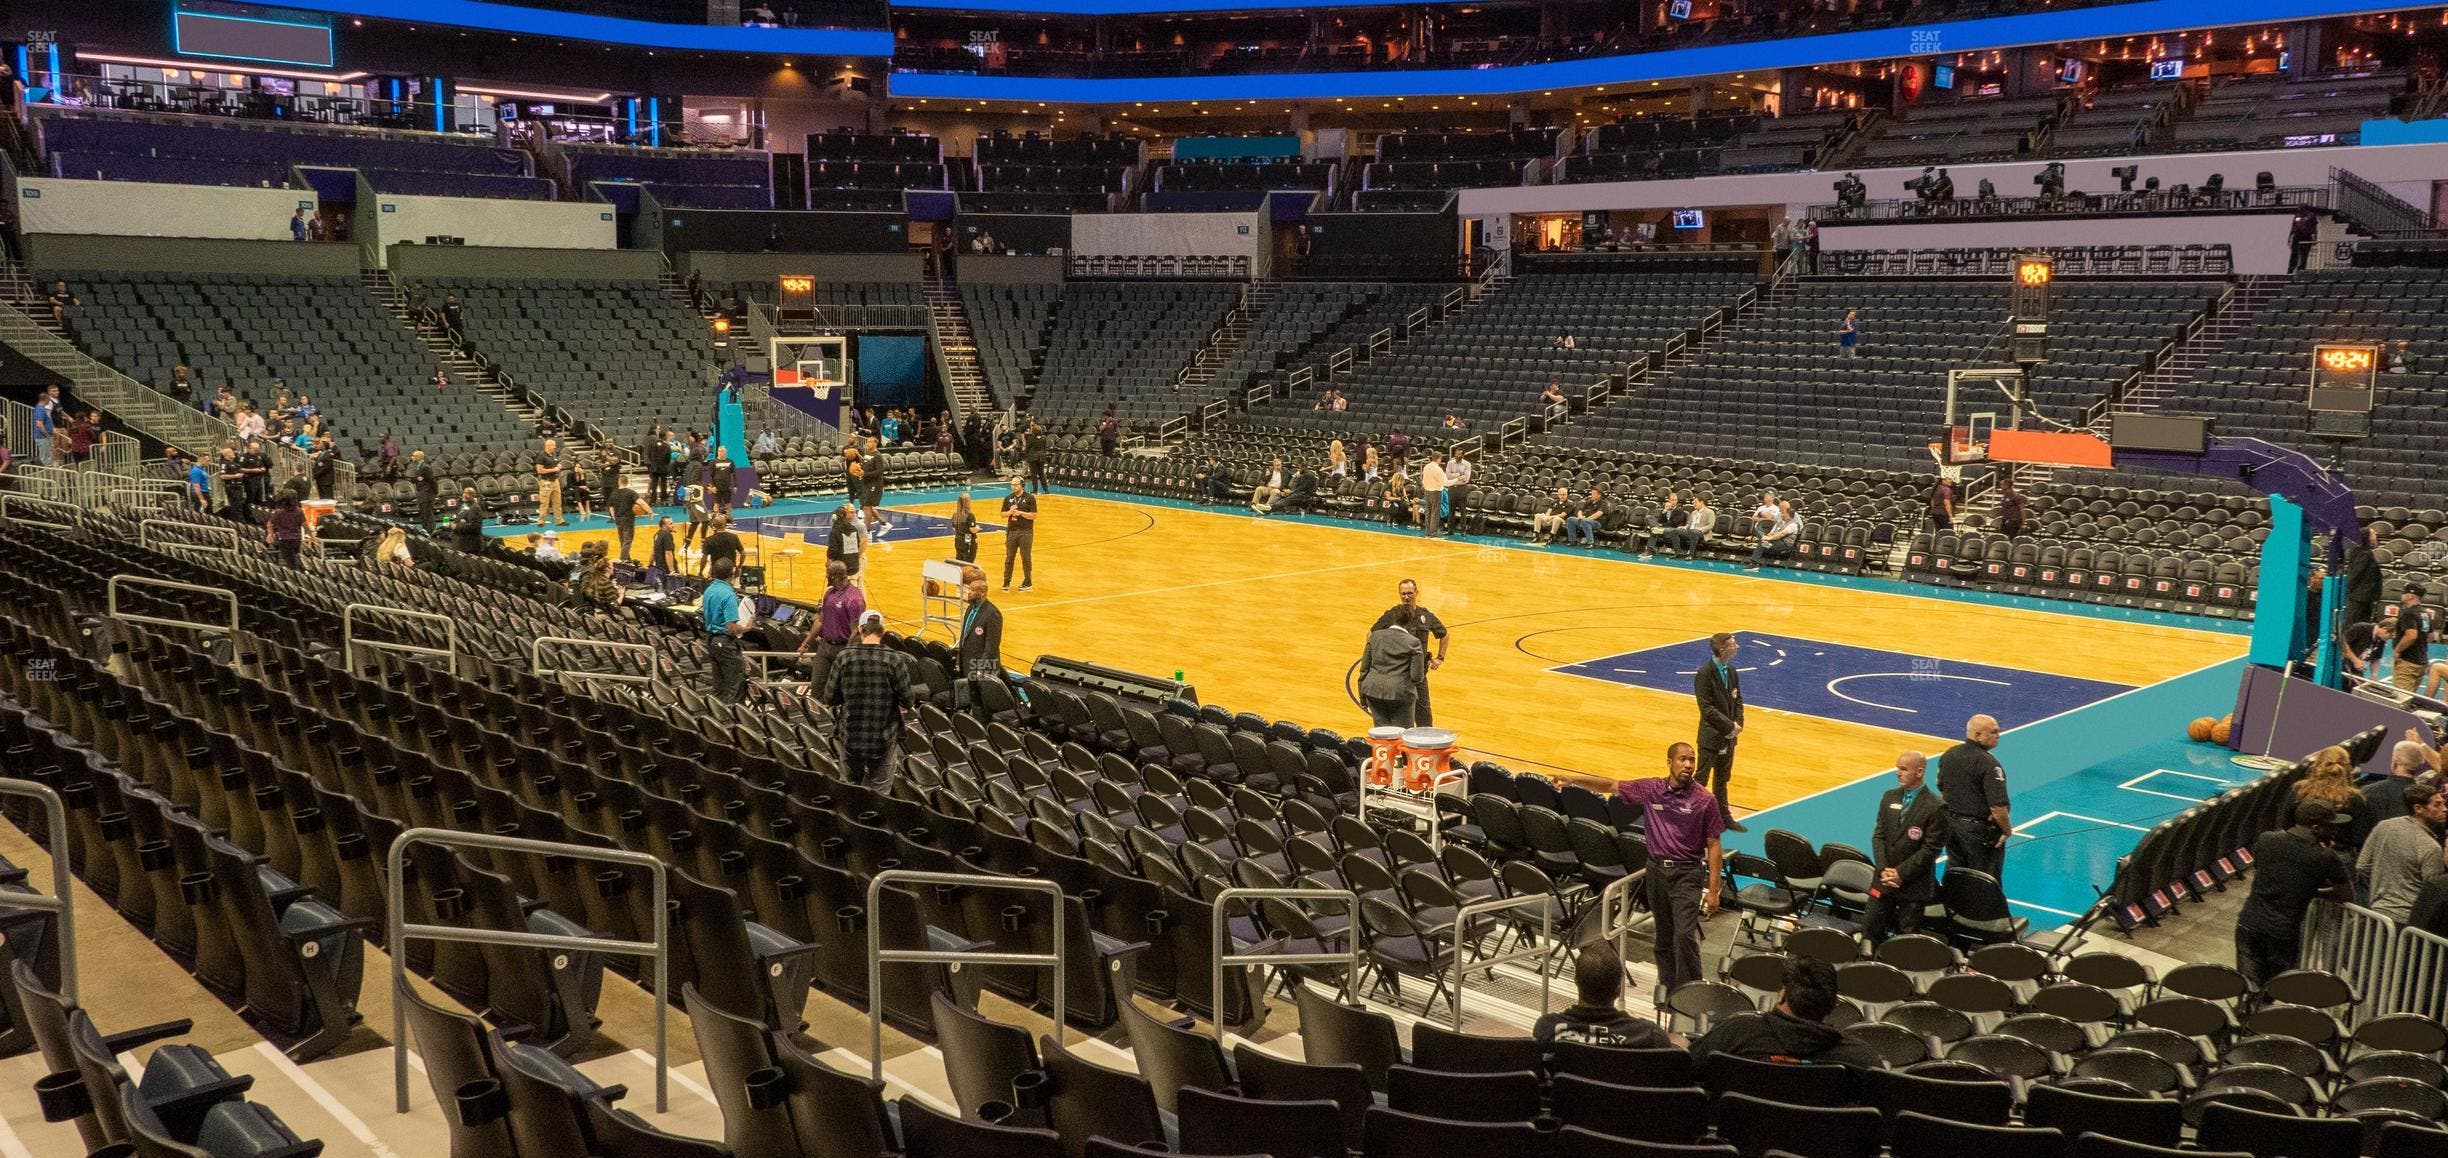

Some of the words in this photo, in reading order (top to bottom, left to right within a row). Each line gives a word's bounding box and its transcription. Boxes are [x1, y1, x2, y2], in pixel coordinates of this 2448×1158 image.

[2323, 351, 2371, 369] 49:24
[1375, 746, 1388, 760] G
[1417, 756, 1430, 771] G
[306, 945, 314, 953] H
